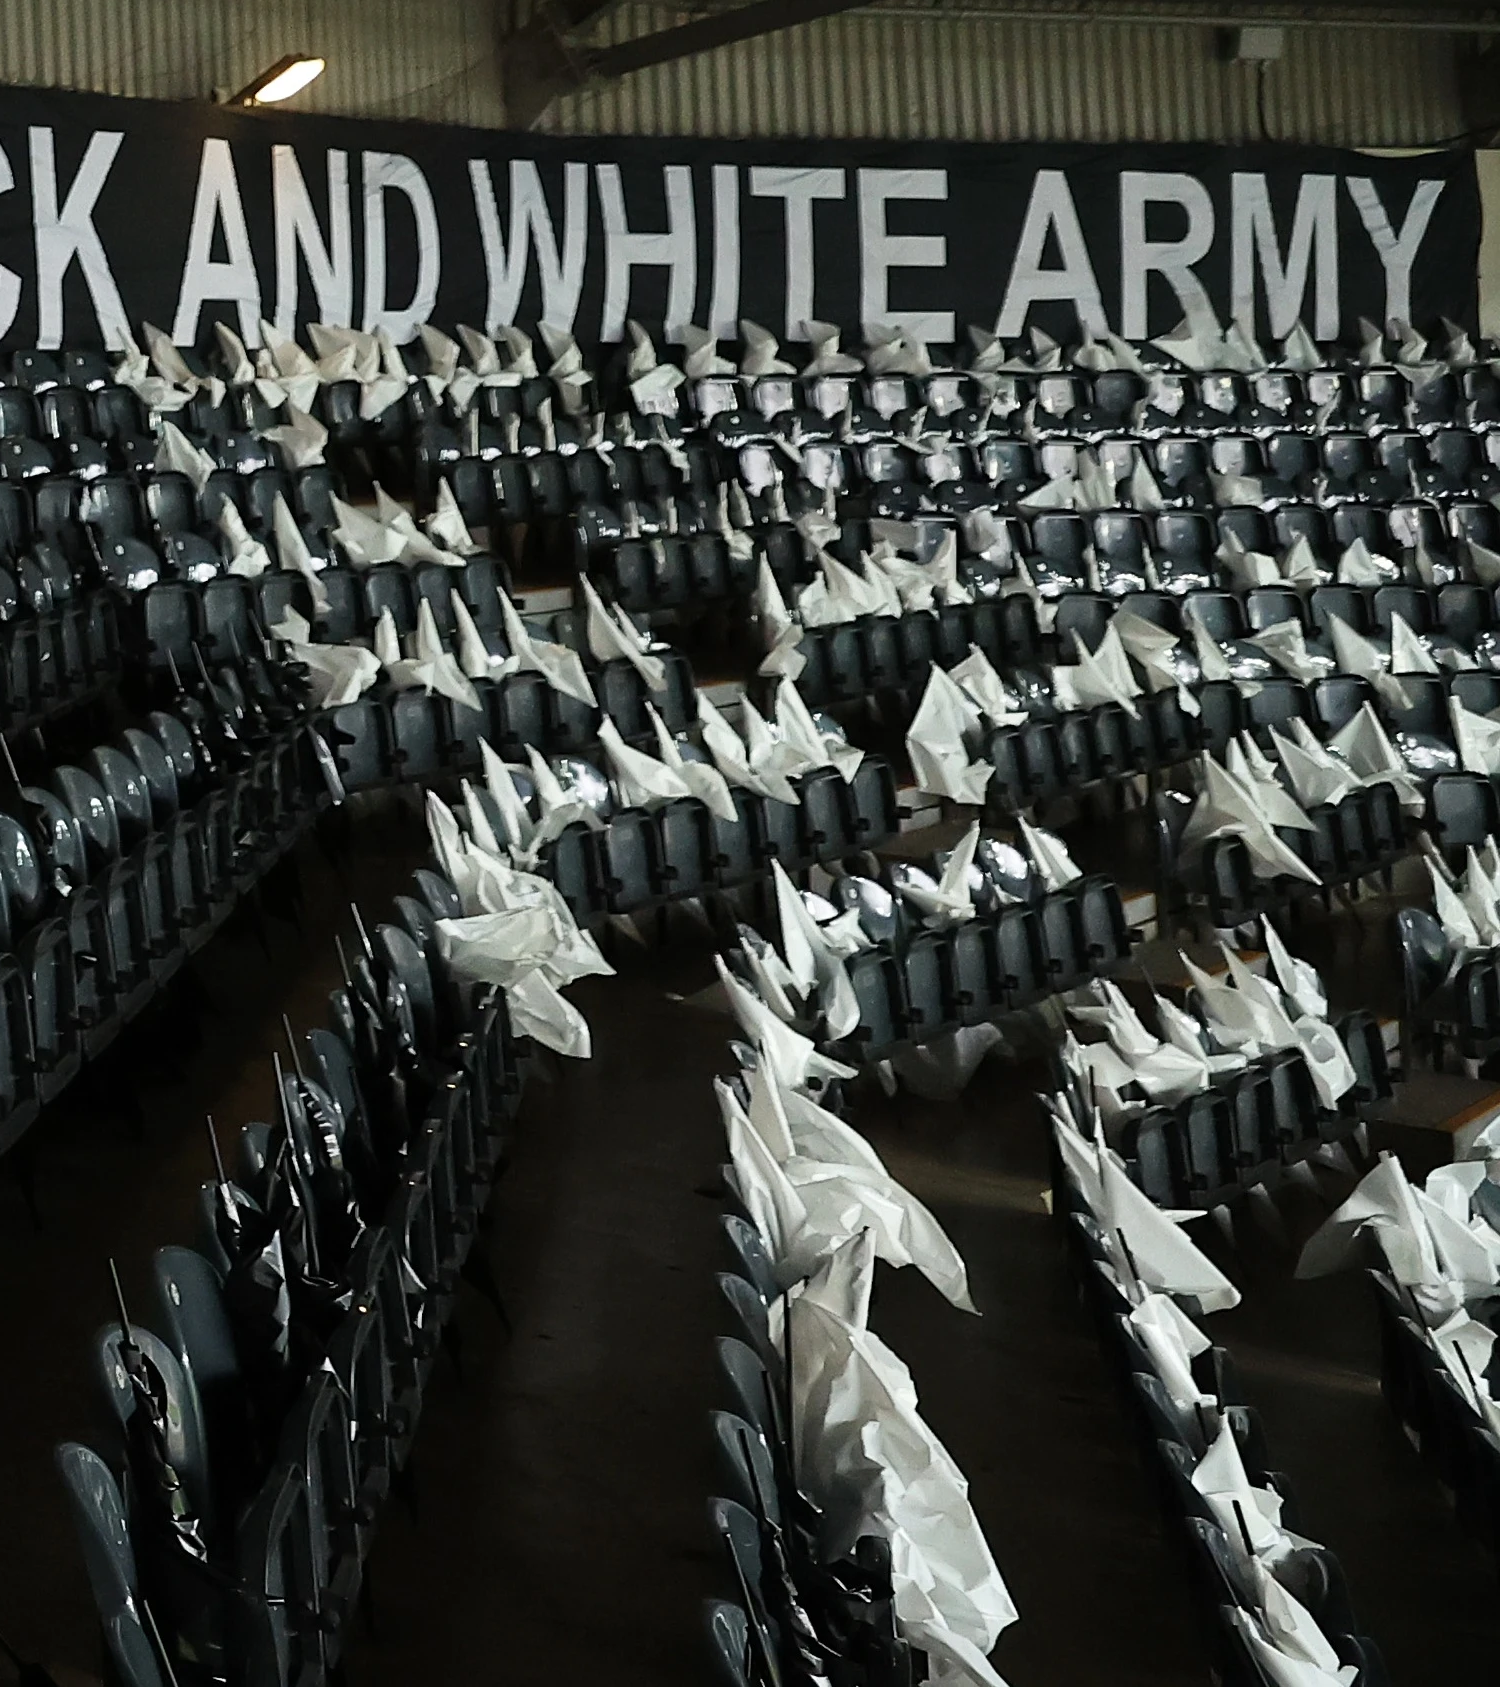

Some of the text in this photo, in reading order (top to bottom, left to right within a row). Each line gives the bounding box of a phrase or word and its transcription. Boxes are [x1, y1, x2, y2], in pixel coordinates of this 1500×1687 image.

[173, 137, 441, 350] AND
[467, 158, 956, 344] WHITE
[995, 170, 1446, 342] ARMY
